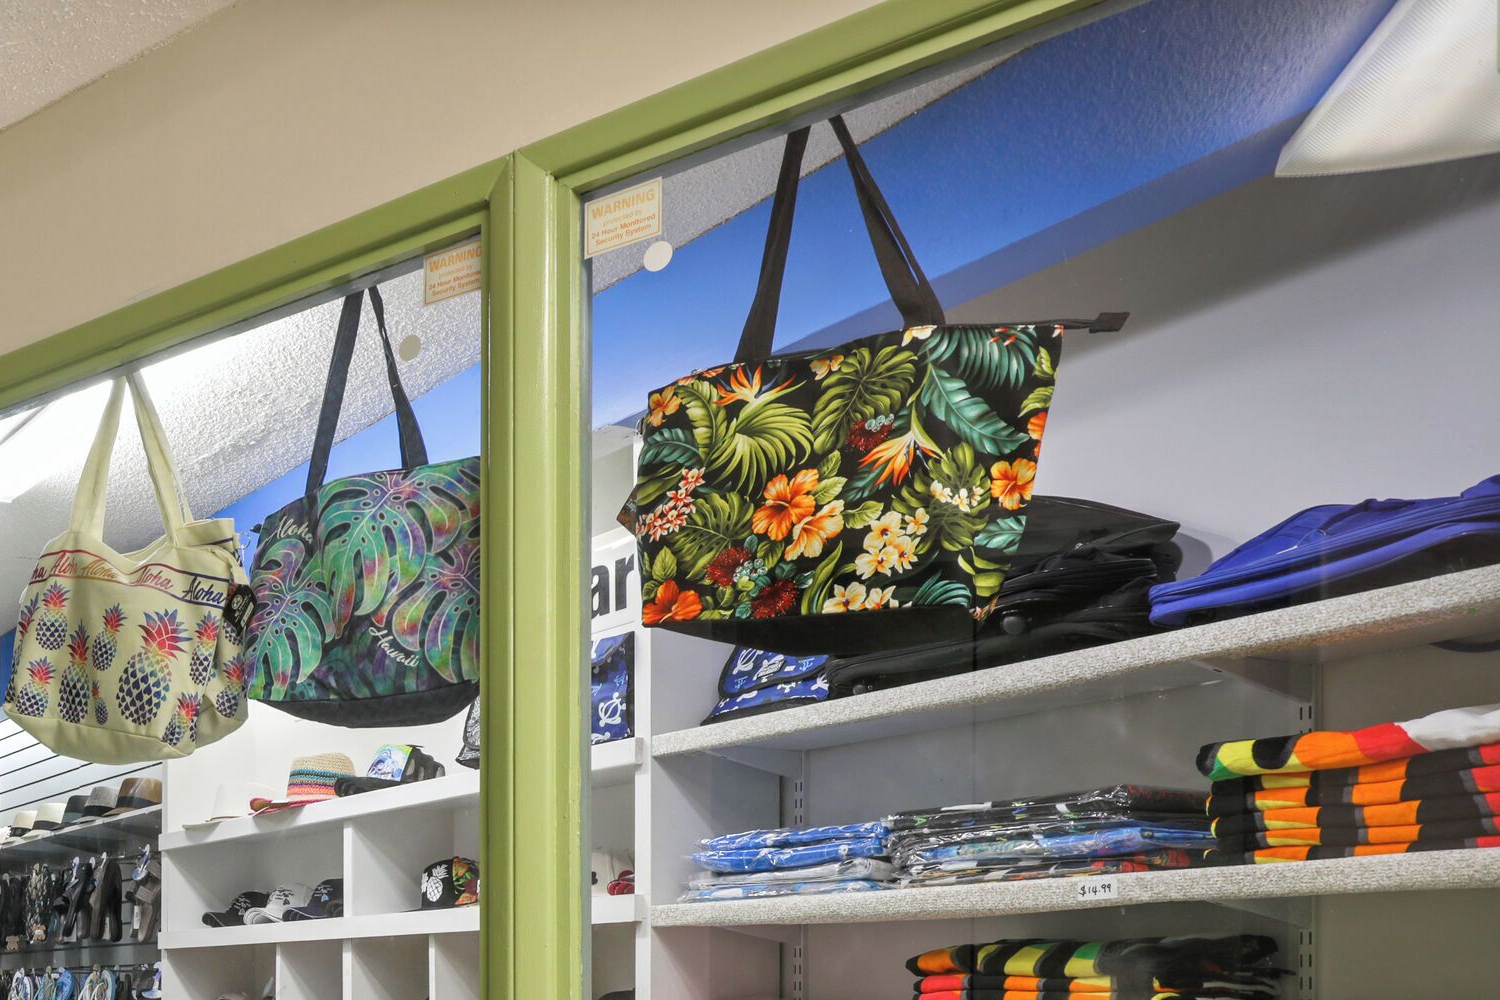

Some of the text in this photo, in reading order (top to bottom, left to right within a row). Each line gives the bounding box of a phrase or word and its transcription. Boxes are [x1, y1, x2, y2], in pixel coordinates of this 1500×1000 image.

[592, 189, 655, 219] WARNING
[592, 213, 656, 240] 24 Hour Monitored
[603, 208, 644, 227] protected by
[595, 223, 652, 246] Security System
[429, 245, 482, 272] WARNING
[432, 286, 455, 297] Security
[436, 279, 452, 288] Hour
[452, 270, 482, 283] Monitore
[264, 515, 314, 544] Aloha
[132, 565, 174, 591] Aloha
[182, 576, 226, 605] Aloha
[368, 626, 421, 668] Hawaii
[1079, 883, 1111, 897] $14.99
